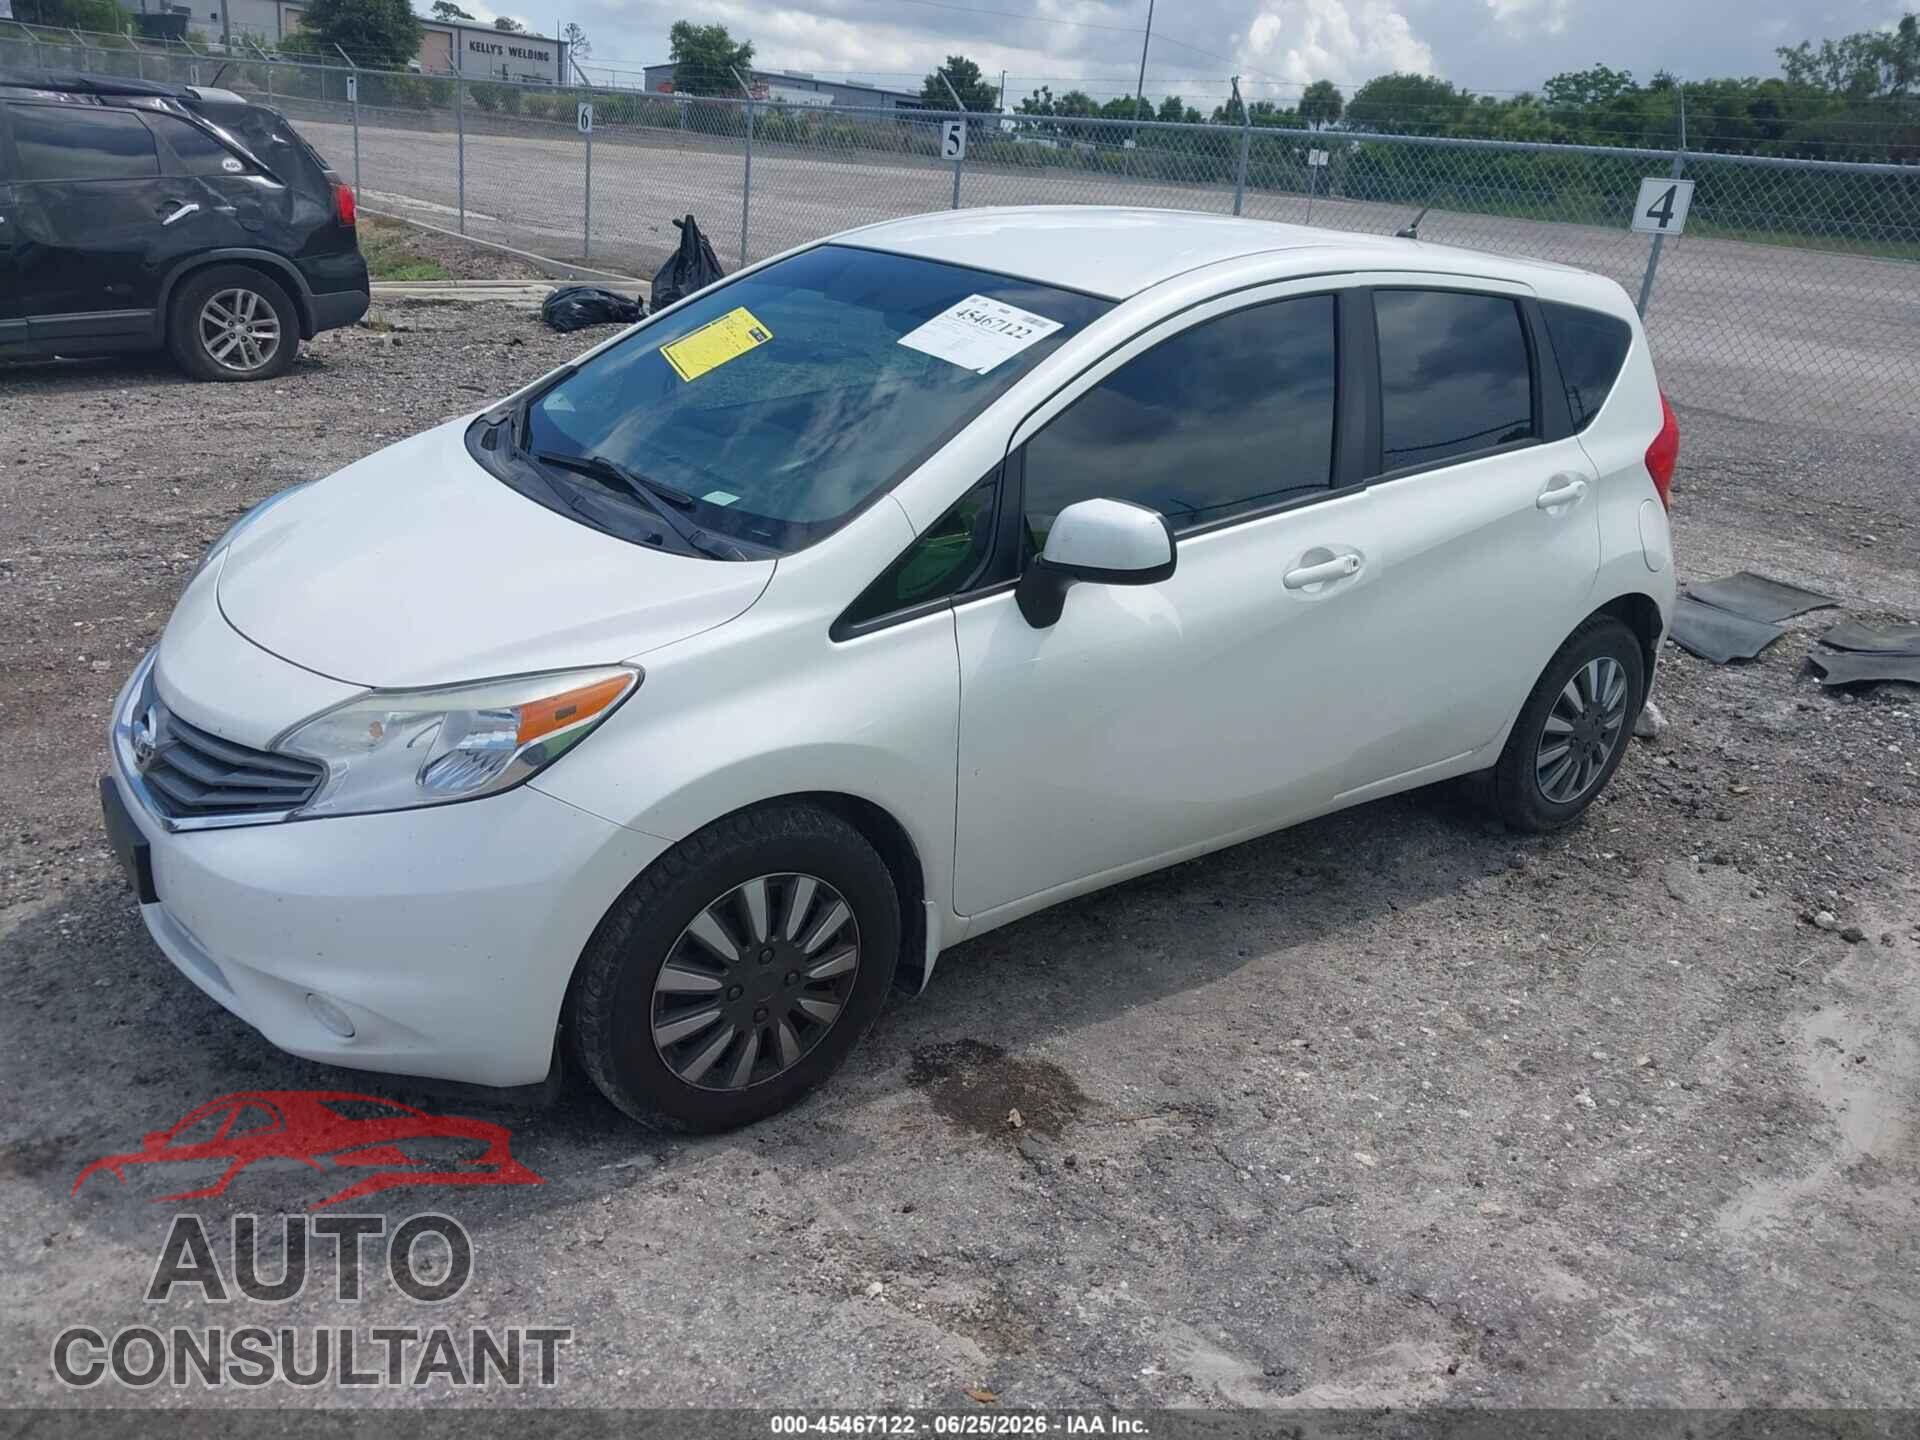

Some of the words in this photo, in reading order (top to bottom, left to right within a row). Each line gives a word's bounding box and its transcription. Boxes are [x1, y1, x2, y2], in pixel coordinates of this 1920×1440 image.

[469, 41, 503, 56] KELLY'S
[508, 47, 550, 62] WELDING
[581, 106, 589, 130] 6
[948, 126, 960, 155] 5
[1646, 184, 1678, 228] 4
[956, 308, 1032, 339] 45467122
